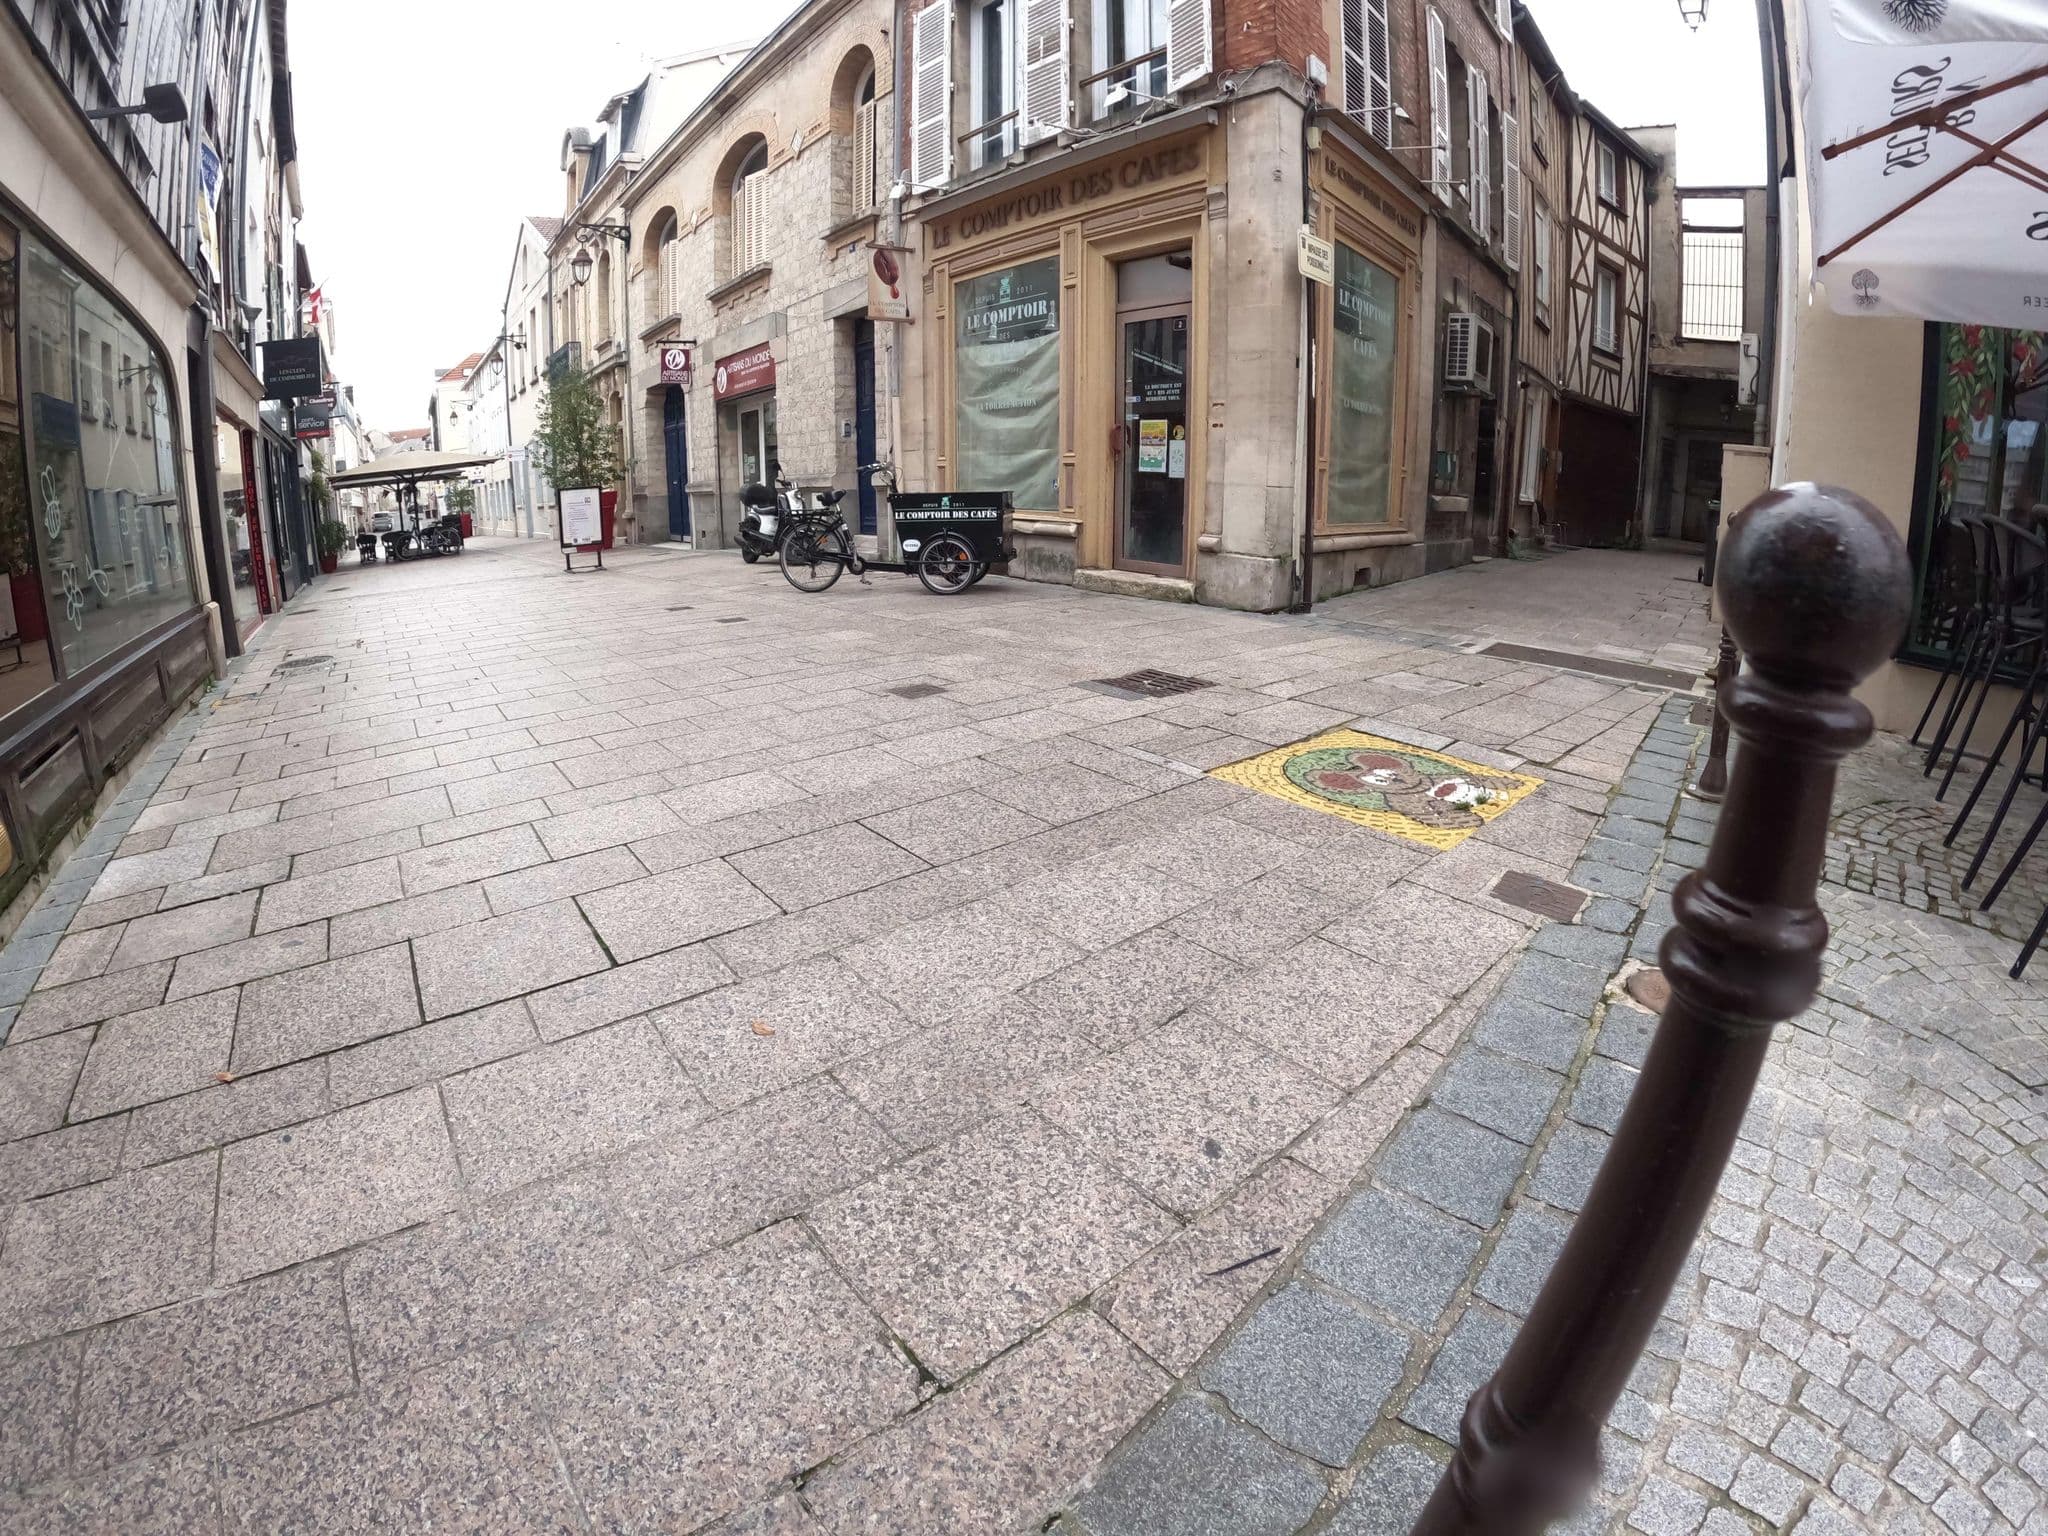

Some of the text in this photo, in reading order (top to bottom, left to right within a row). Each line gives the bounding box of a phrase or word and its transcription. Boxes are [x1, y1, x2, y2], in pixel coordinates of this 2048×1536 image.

[932, 229, 951, 250] LE
[960, 184, 1064, 240] COMPTOIR
[1068, 166, 1114, 206] DES
[1339, 288, 1350, 310] LE
[967, 299, 1048, 330] LE COMPTOIR
[727, 359, 745, 374] ARTISANS
[744, 356, 752, 369] DU
[751, 348, 770, 366] MONDE
[662, 369, 689, 377] ARTISANS
[297, 420, 326, 430] service
[895, 511, 905, 520] LE
[906, 510, 950, 520] COMPTOIR
[952, 509, 969, 519] DES
